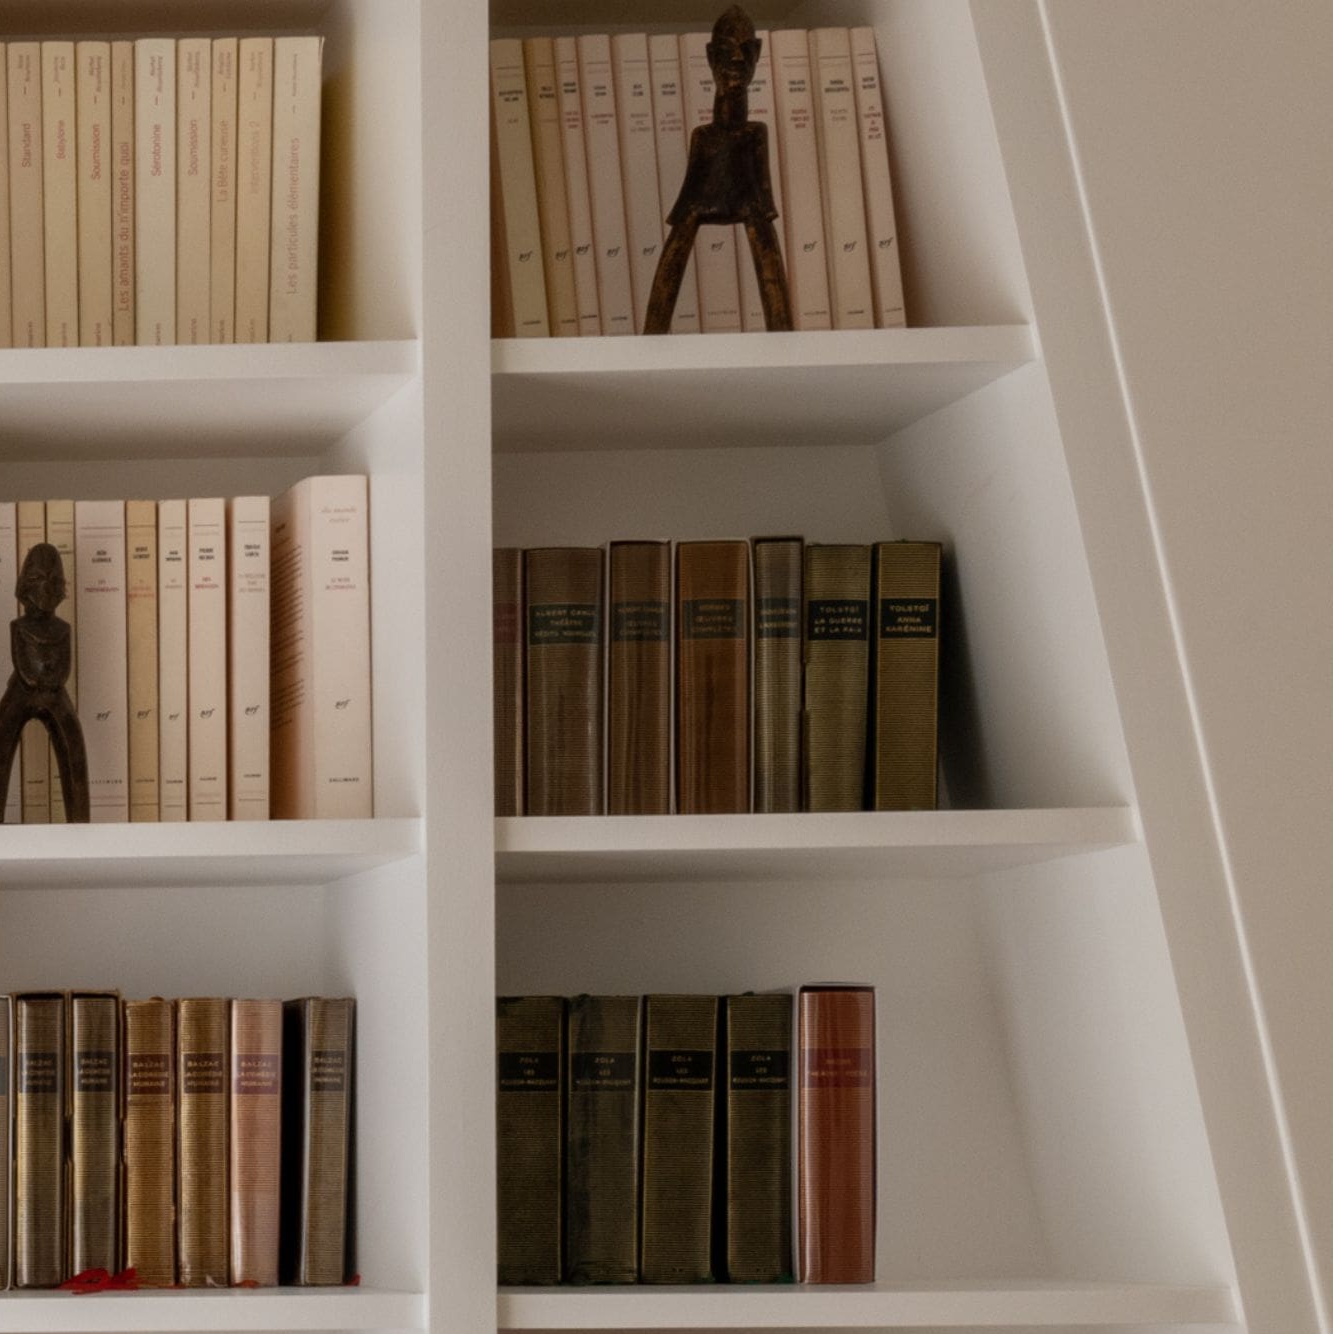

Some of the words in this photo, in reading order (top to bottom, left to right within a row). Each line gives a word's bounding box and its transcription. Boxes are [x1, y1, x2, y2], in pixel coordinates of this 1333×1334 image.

[21, 123, 31, 168] Standard
[56, 120, 67, 160] Babylone
[151, 124, 161, 176] Sérotonine
[188, 119, 199, 176] Soumission
[217, 120, 229, 162] curieuse
[91, 124, 101, 180] Soumission
[118, 142, 131, 166] quoi
[249, 130, 261, 194] Interventions
[216, 164, 229, 188] Bête
[287, 138, 299, 210] élémentaires
[117, 170, 131, 223] n'importe
[217, 190, 229, 203] La
[118, 226, 130, 241] du
[287, 214, 300, 270] particules
[119, 246, 130, 286] amants
[286, 274, 298, 294] Les
[119, 290, 130, 312] Les
[536, 608, 567, 617] ALBERT
[819, 604, 859, 613] TOLSTOÏ
[889, 602, 930, 612] TOLSTOÏ
[814, 626, 826, 634] ET
[885, 624, 933, 633] KARÉNINE
[896, 616, 922, 624] ANNA
[187, 1060, 219, 1068] BALZAC
[240, 1060, 271, 1068] BALZAC
[519, 1056, 539, 1064] ZOLA
[595, 1056, 615, 1064] ZOLA
